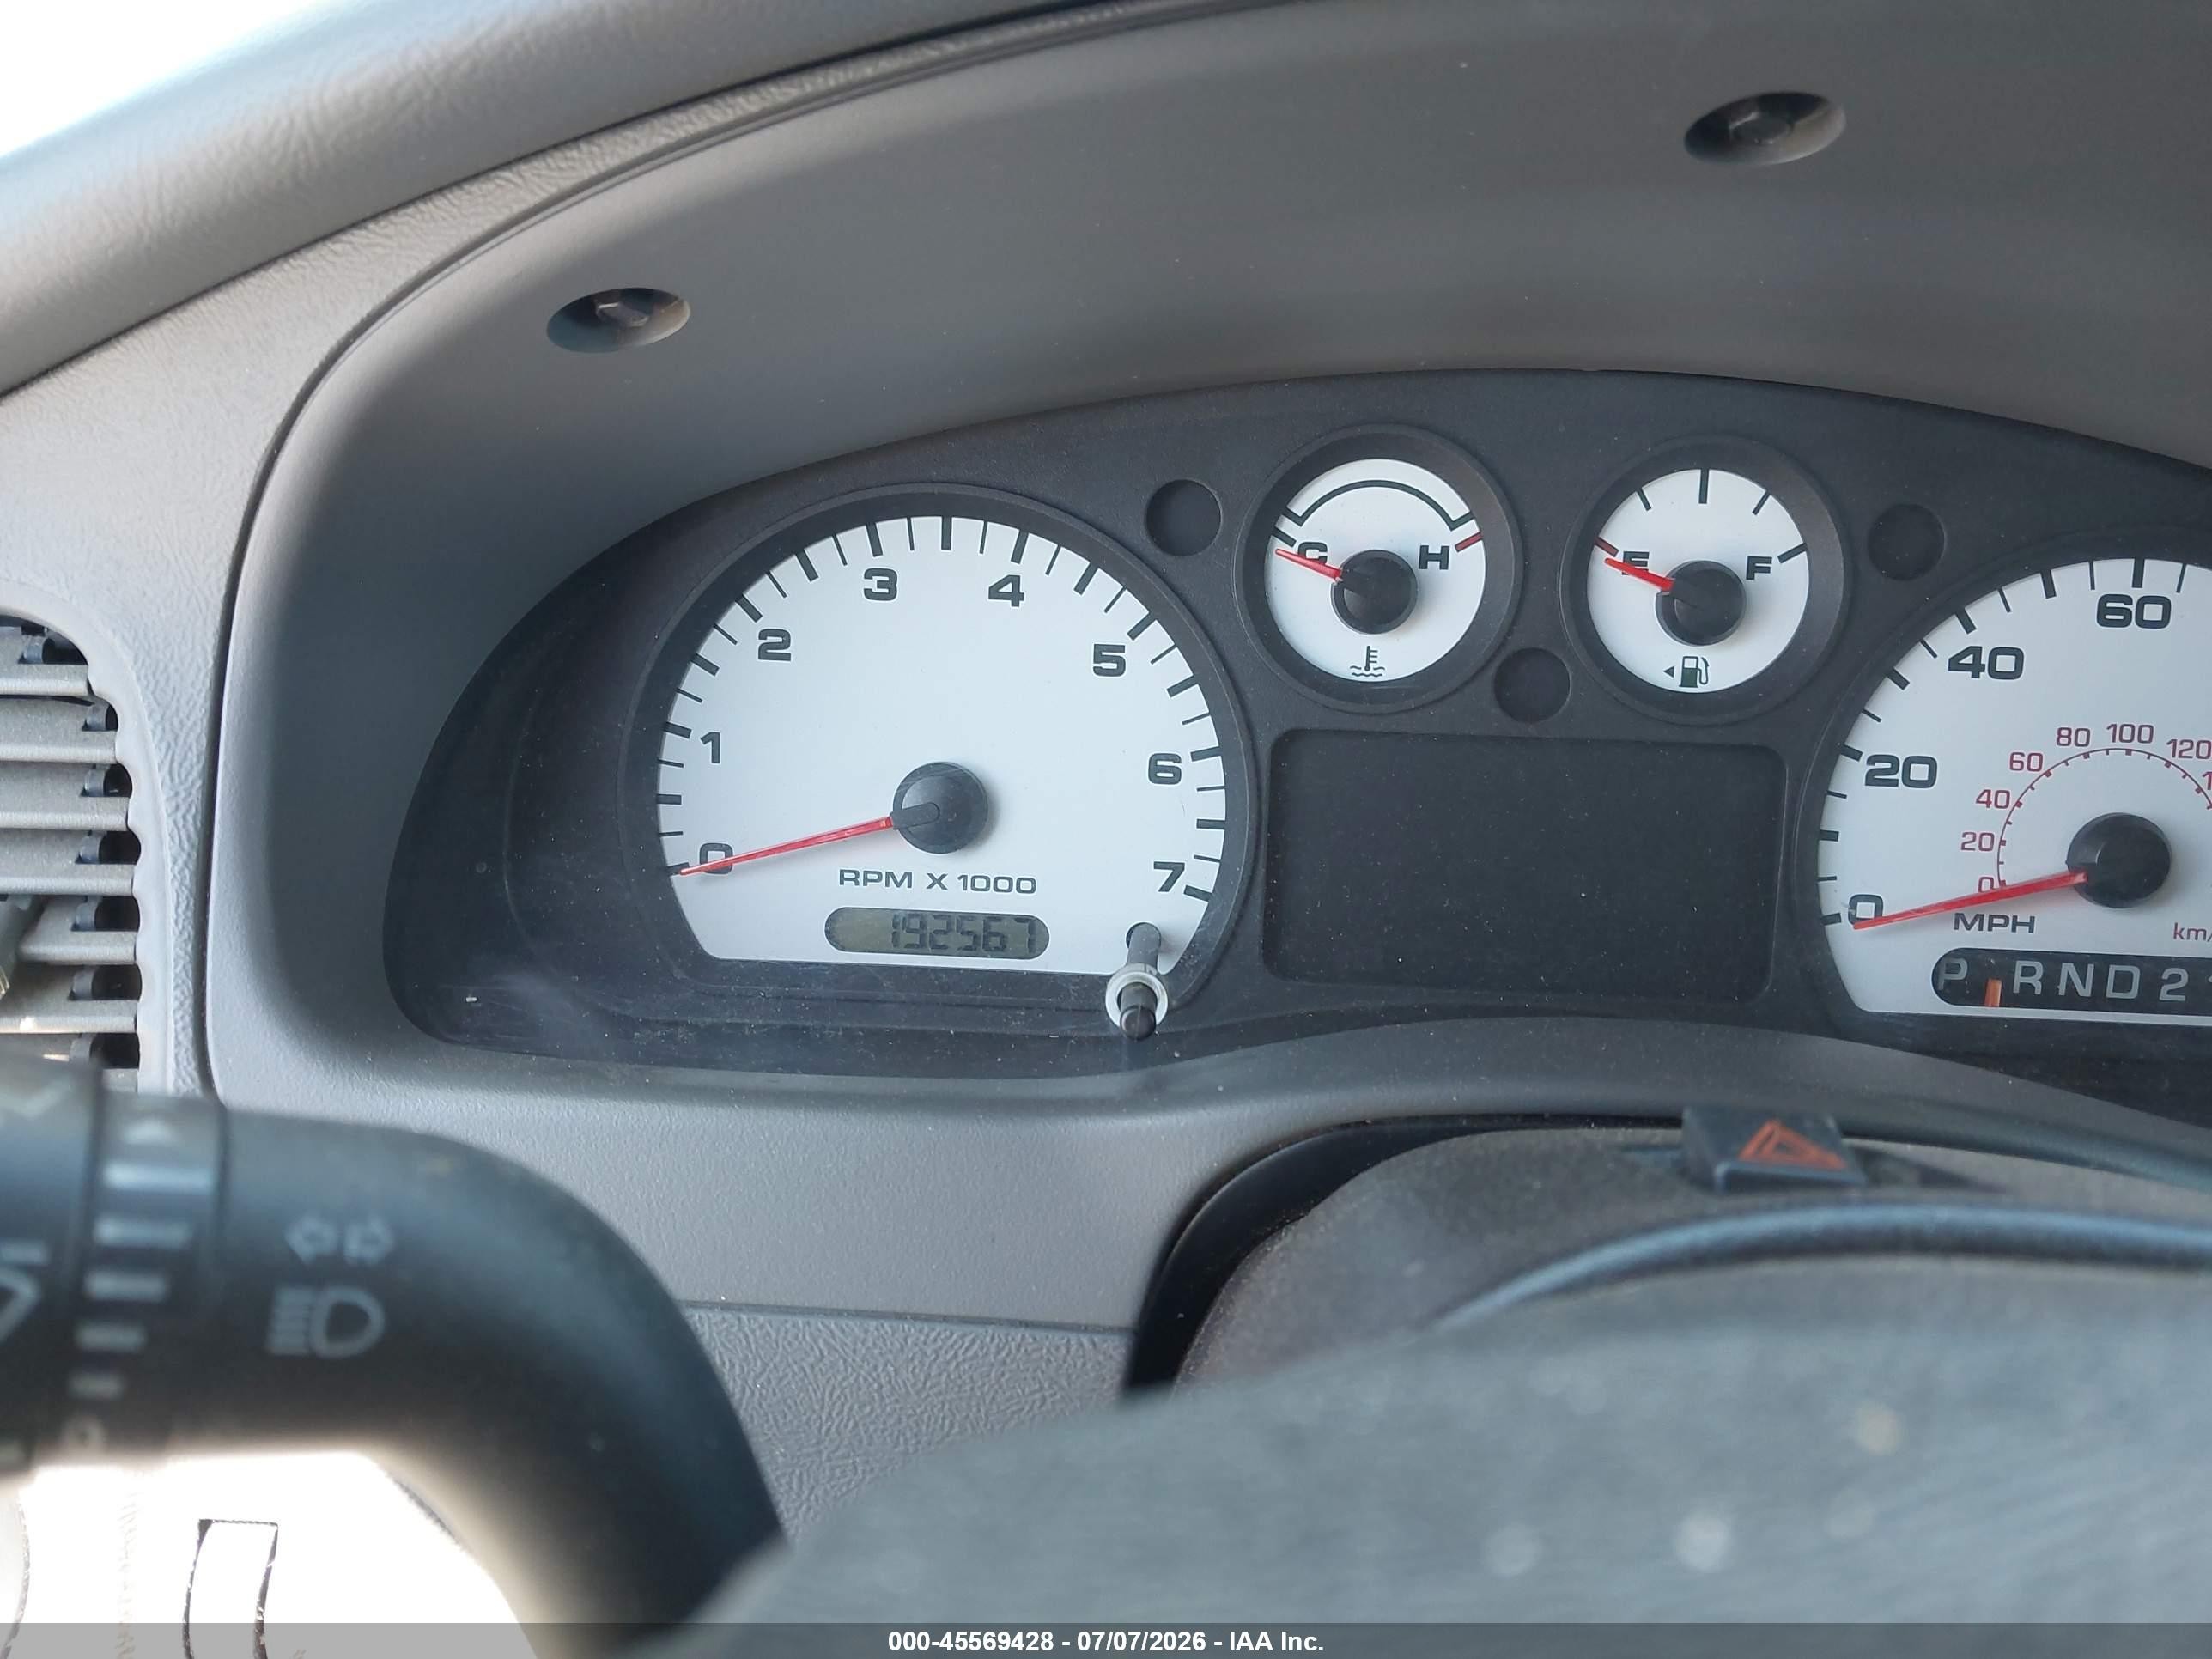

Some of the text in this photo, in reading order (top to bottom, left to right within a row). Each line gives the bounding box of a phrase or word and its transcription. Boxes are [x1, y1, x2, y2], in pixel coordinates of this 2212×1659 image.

[1297, 542, 1328, 563] C
[1419, 546, 1449, 569] H
[1622, 551, 1648, 575] E
[1747, 556, 1771, 580] F
[864, 568, 897, 601] 3
[988, 575, 1024, 606] 4
[2097, 594, 2172, 629] 60
[758, 629, 791, 661] 2
[1093, 645, 1126, 676] 5
[1948, 646, 2024, 679] 40
[701, 732, 720, 763] 1
[2057, 727, 2090, 747] 80
[2106, 724, 2154, 744] 100
[2009, 752, 2044, 772] 60
[2166, 739, 2212, 759] 120
[1148, 753, 1182, 785] 6
[1865, 754, 1936, 788] 20
[1976, 789, 2010, 809] 40
[1960, 832, 1995, 852] 20
[700, 843, 733, 874] 0
[840, 869, 1036, 894] RPM X 1000
[1153, 862, 1185, 893] 7
[1978, 877, 1995, 893] 0
[1848, 894, 1883, 926] 0
[1954, 913, 2035, 933] MPH
[891, 913, 1036, 953] 192567
